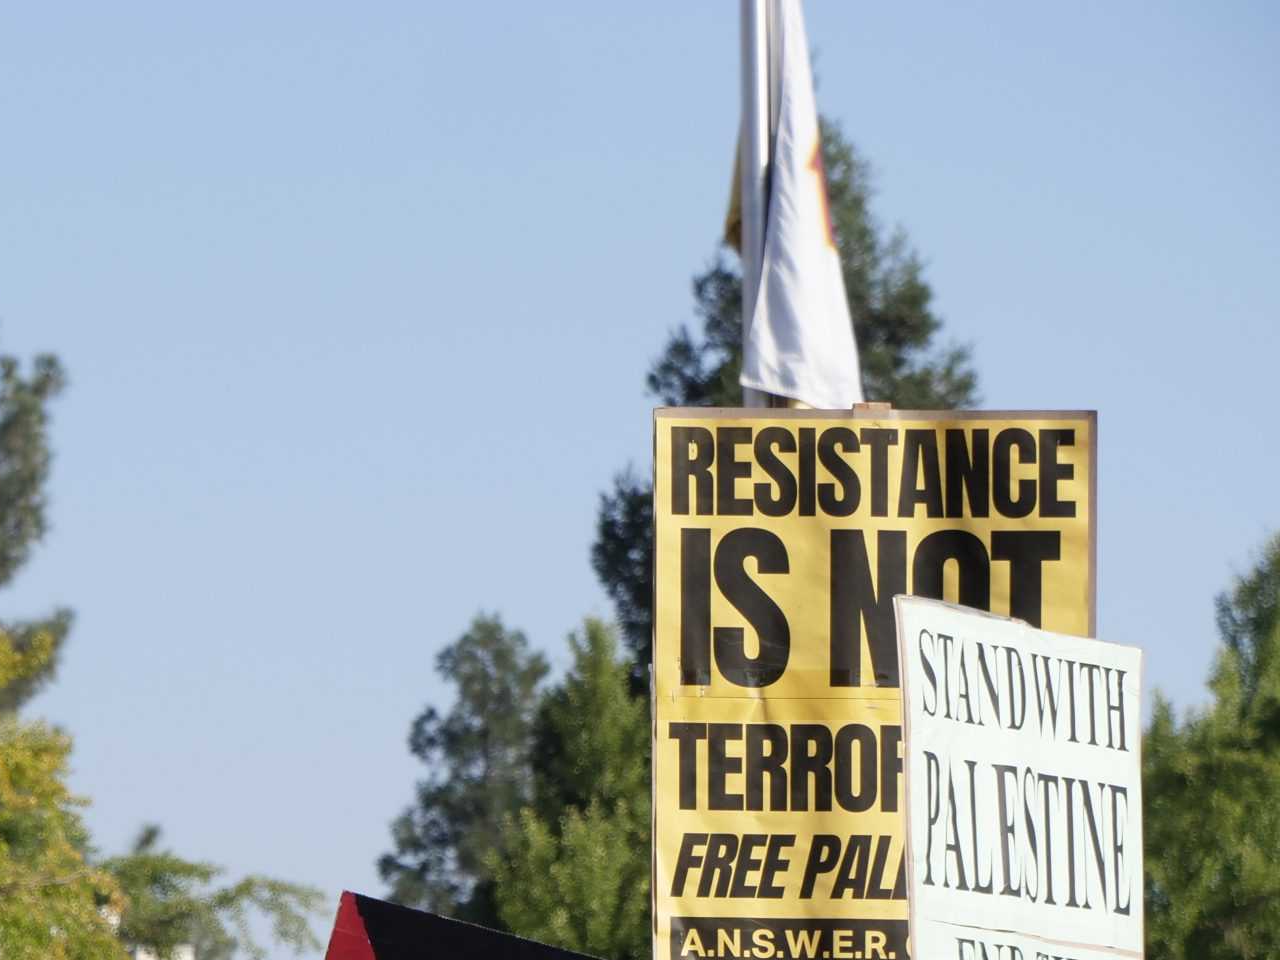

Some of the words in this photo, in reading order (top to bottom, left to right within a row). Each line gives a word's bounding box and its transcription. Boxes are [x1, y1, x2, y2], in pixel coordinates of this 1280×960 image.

[670, 426, 1076, 518] RESISTANCE
[680, 527, 791, 688] IS
[919, 628, 1026, 730] STAND
[1031, 653, 1129, 751] WITH
[670, 832, 796, 899] FREE
[799, 834, 908, 900] PAL
[923, 750, 1130, 916] PALESTINE
[680, 928, 896, 960] A.N.S.W.E.R.
